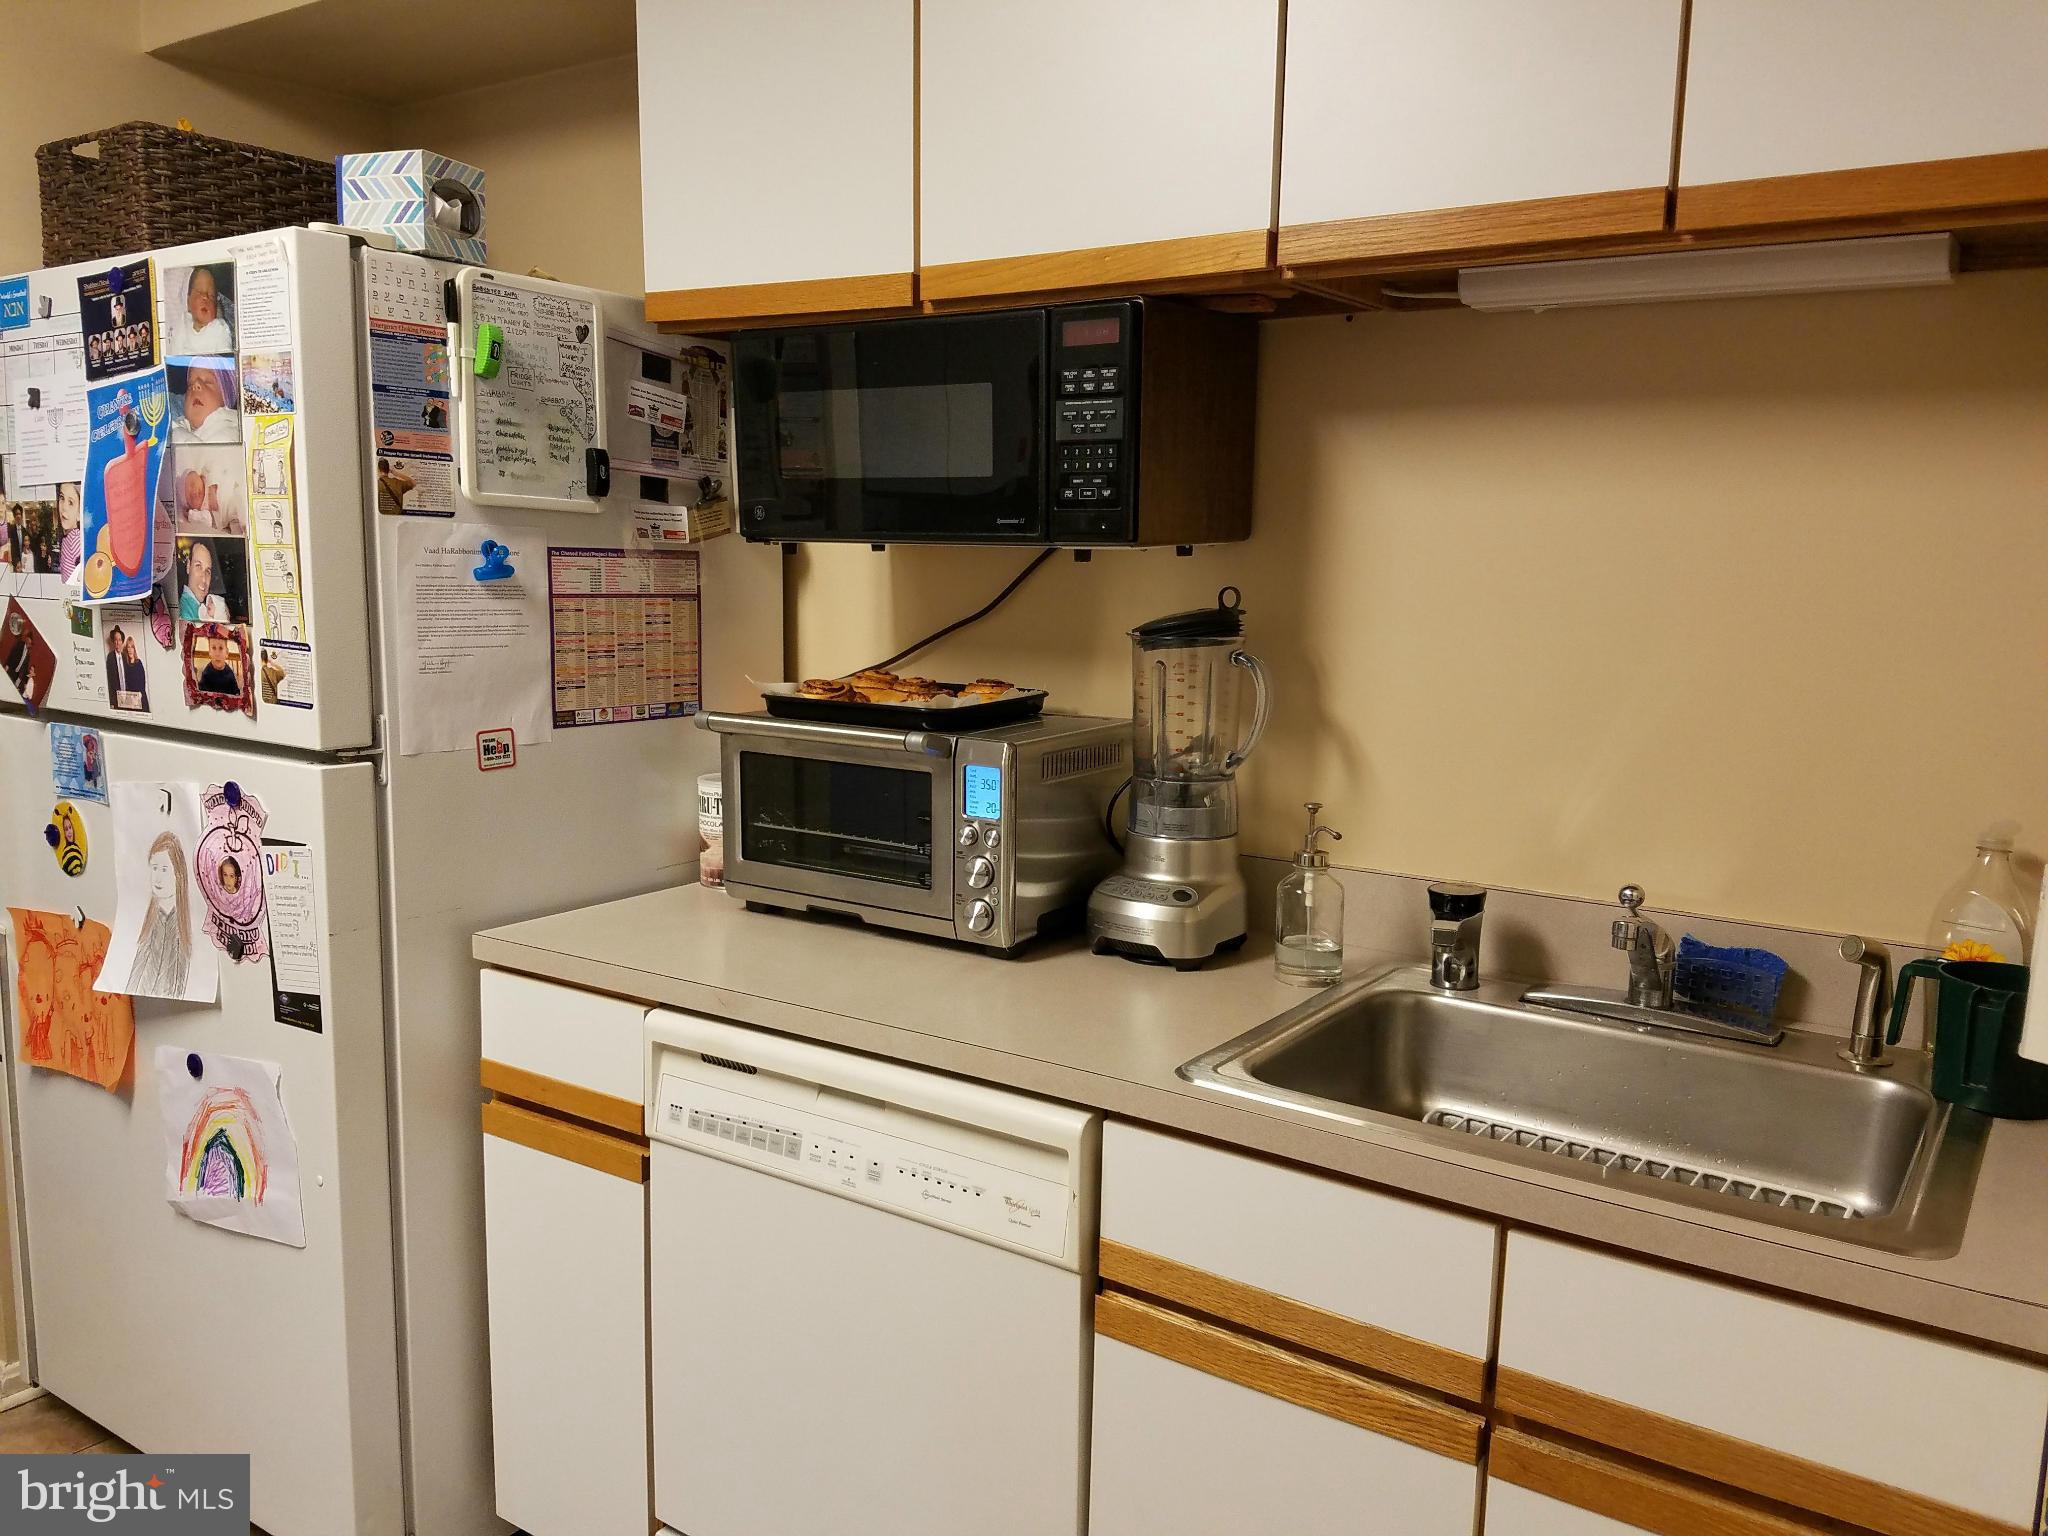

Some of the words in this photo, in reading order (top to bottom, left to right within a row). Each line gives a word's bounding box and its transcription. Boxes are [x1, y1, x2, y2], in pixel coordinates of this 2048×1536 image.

[56, 338, 77, 346] WEDNESDAY
[424, 547, 440, 555] Vaad
[441, 547, 481, 556] HaRabbonim
[980, 779, 997, 790] 350
[986, 802, 997, 813] 20
[266, 853, 288, 875] DID
